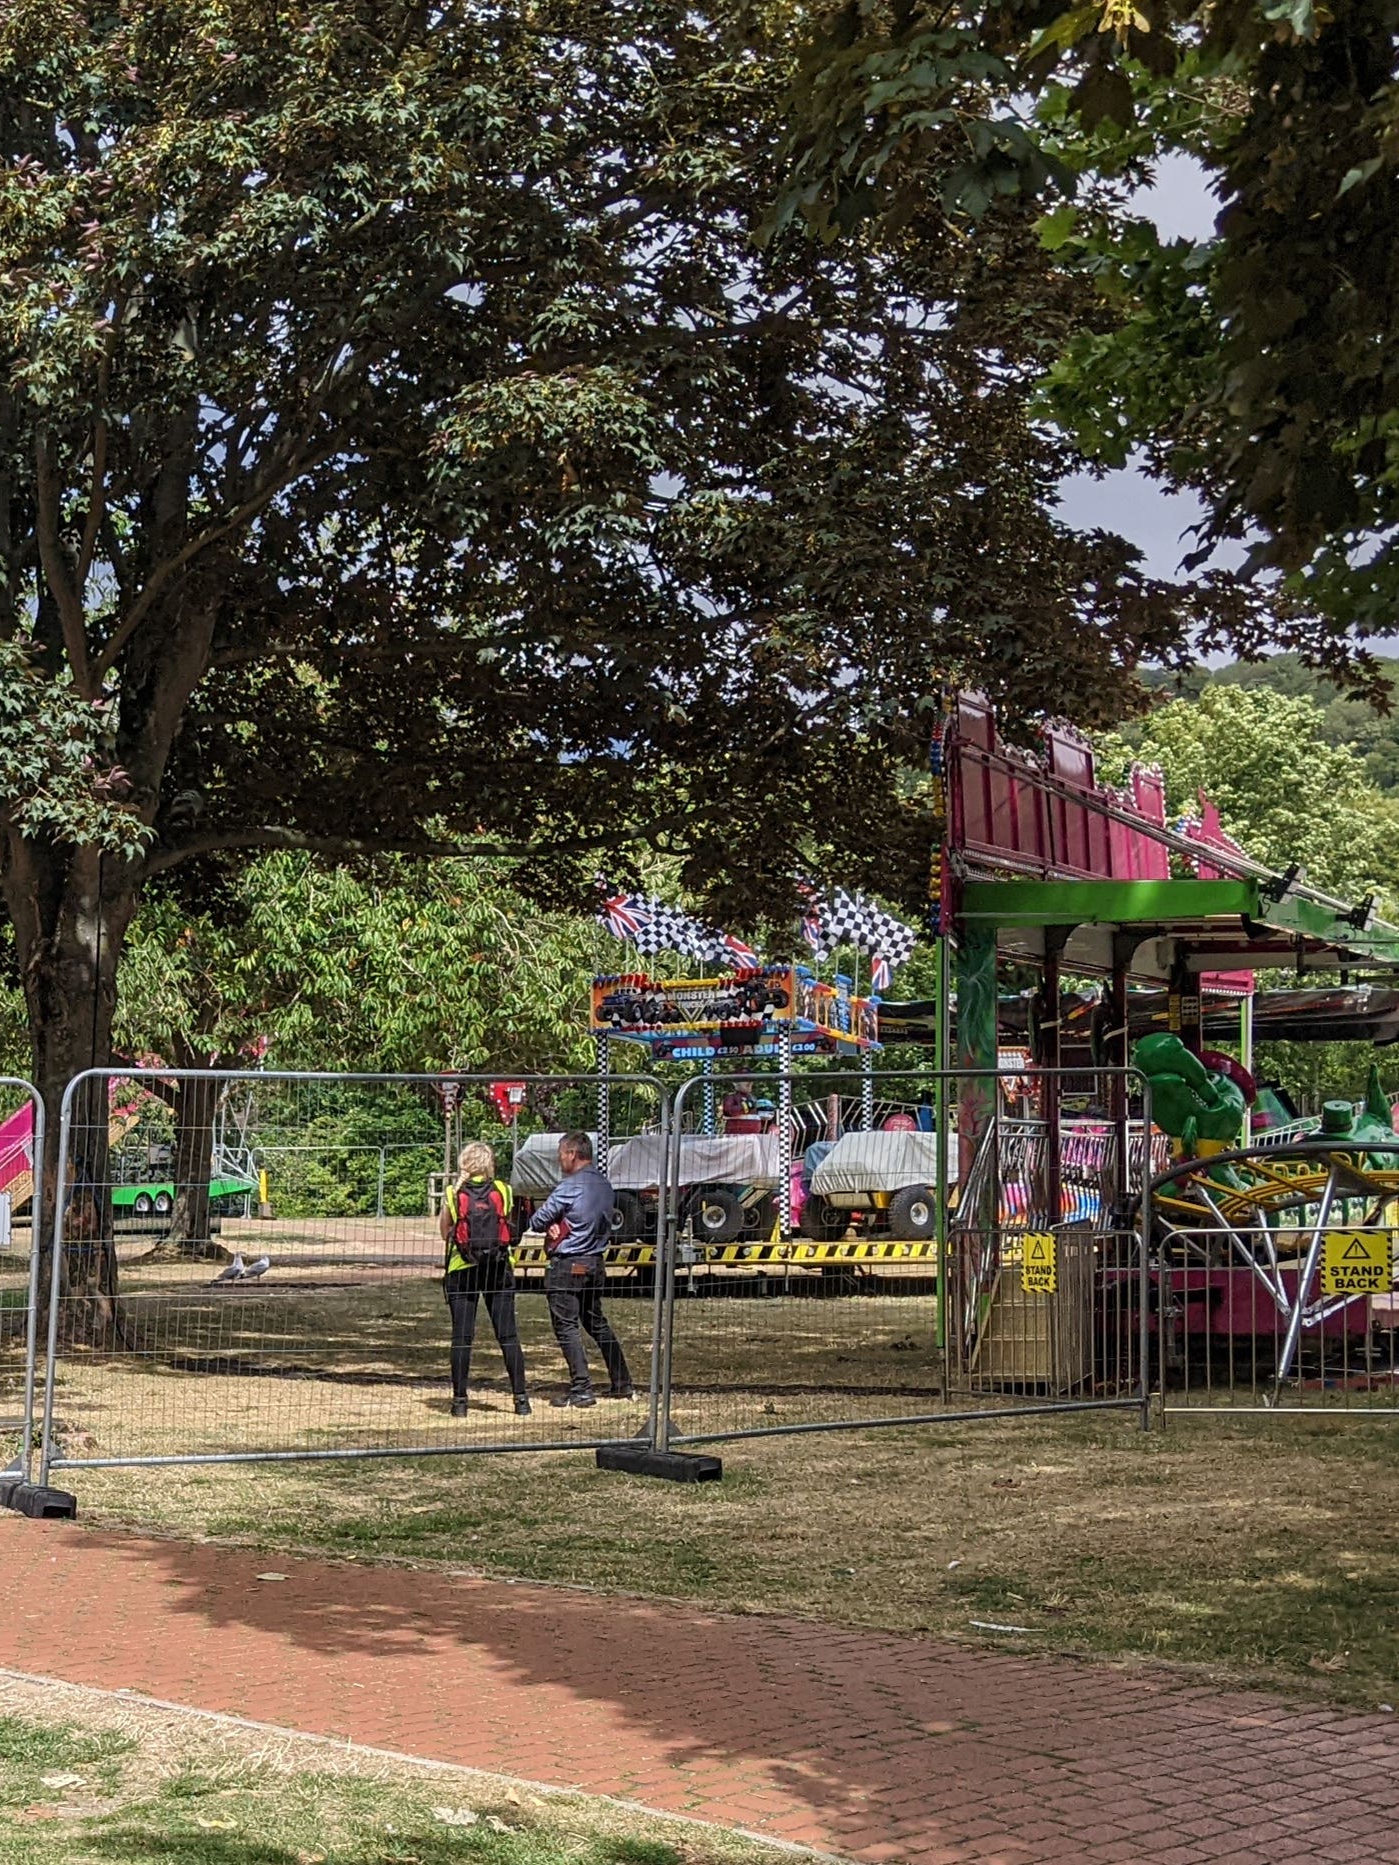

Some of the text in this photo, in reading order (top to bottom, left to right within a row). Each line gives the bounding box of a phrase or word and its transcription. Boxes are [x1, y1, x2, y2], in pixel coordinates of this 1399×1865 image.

[672, 1045, 715, 1058] CHILD
[1025, 1265, 1052, 1276] STAND
[1330, 1265, 1384, 1277] STAND
[1028, 1277, 1050, 1287] BACK
[1334, 1278, 1379, 1289] BACK
